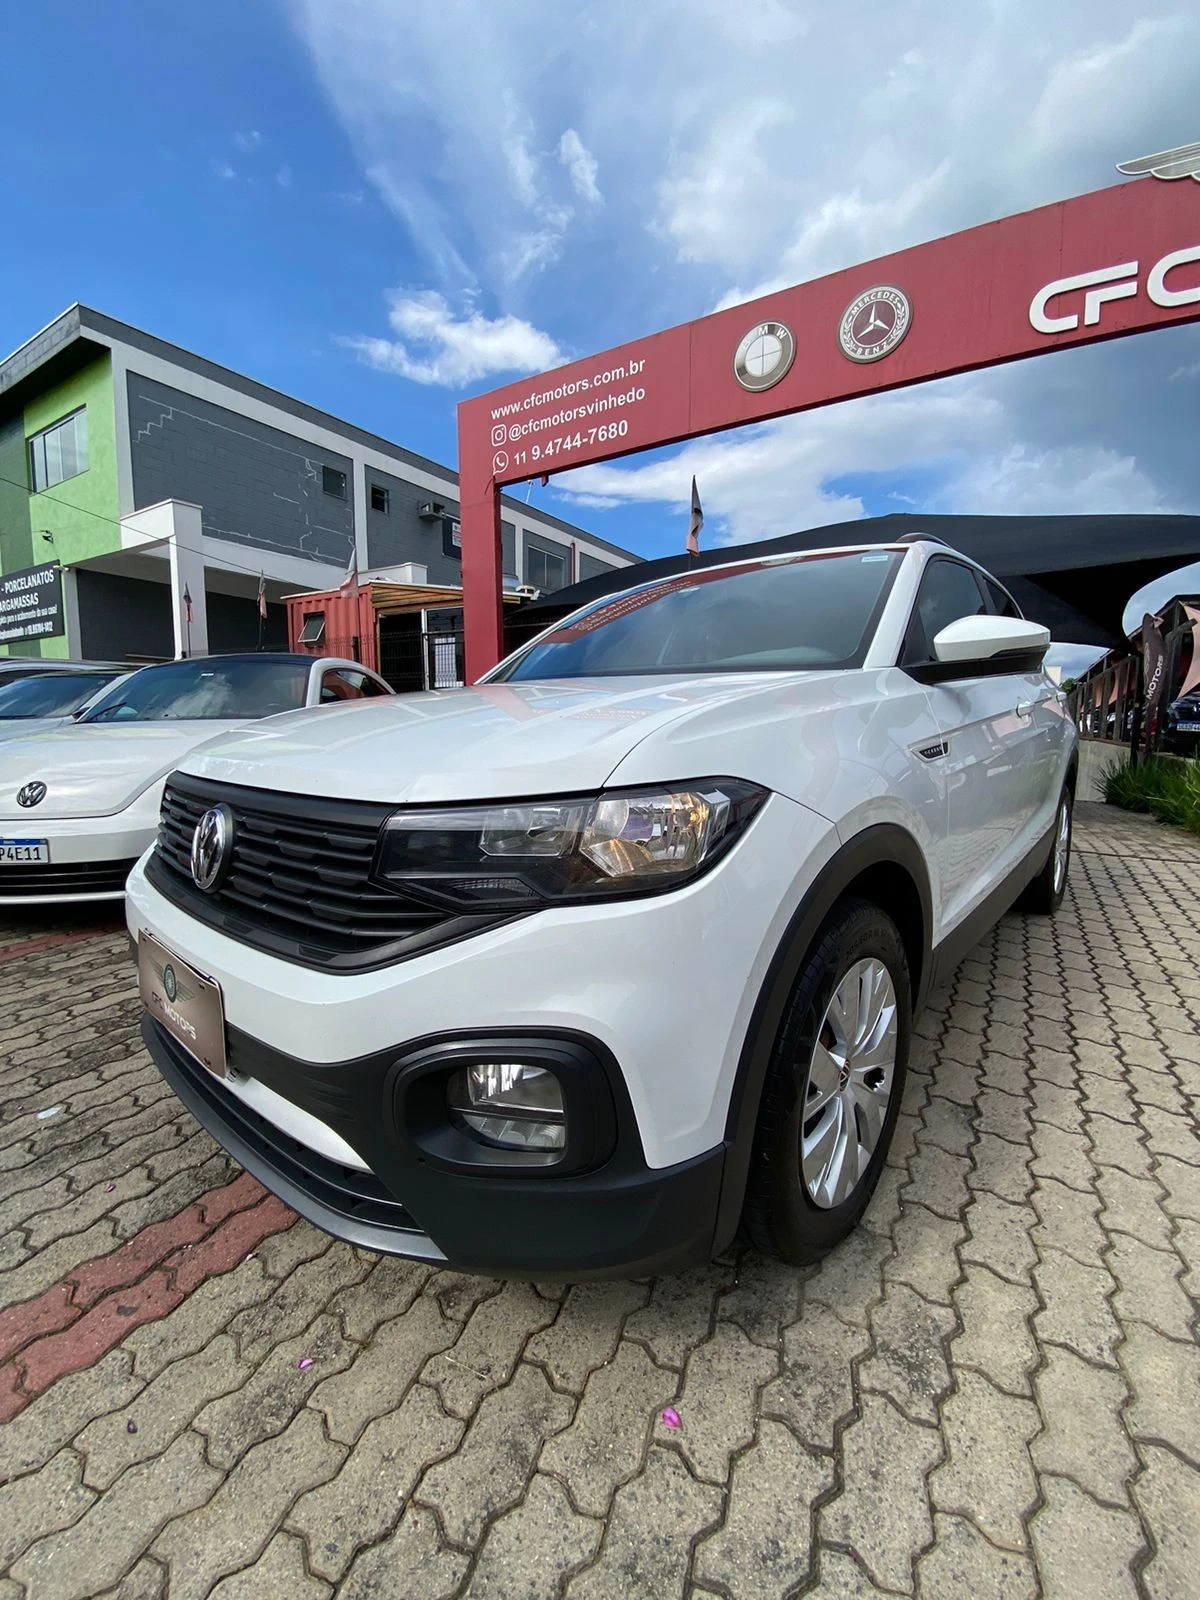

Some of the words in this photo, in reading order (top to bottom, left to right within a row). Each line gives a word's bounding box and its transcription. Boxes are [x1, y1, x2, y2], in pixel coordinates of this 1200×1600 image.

[851, 290, 900, 316] MERCEDES
[856, 342, 888, 356] BENZ
[491, 359, 645, 420] www.cfcmotors.com.br
[509, 387, 645, 441] @cfcmotorsvinhedo
[514, 451, 527, 466] 11
[531, 420, 628, 461] 9.4744-7680
[4, 569, 55, 594] PORCELANATOS
[1146, 654, 1164, 700] MOTORS
[164, 1002, 197, 1040] MOTORS
